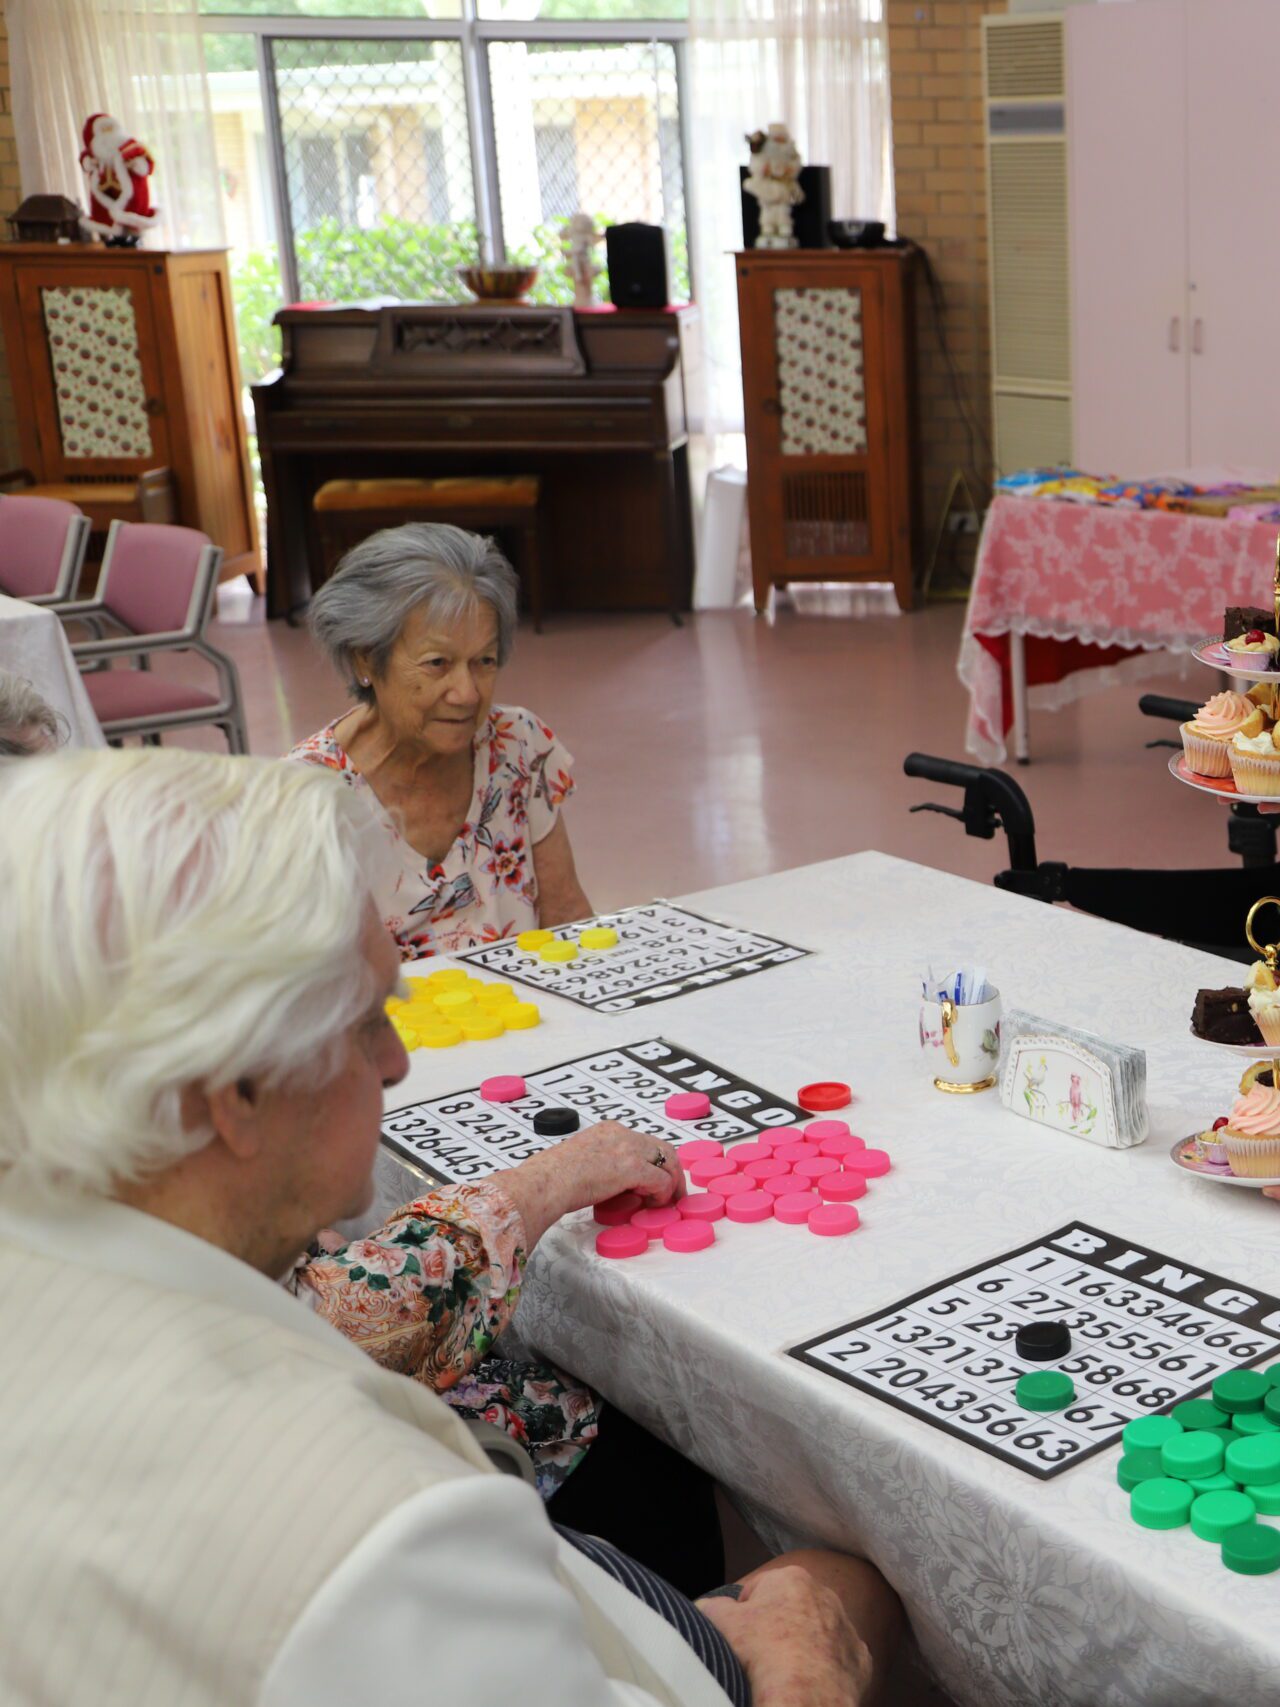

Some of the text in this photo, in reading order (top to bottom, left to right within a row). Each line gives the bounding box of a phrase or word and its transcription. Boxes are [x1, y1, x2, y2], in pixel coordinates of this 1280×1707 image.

[571, 986, 619, 1000] 72
[543, 1074, 574, 1086] 1
[559, 1086, 609, 1105] 25
[627, 1041, 796, 1126] BINGO
[439, 1102, 474, 1114] 8
[590, 1060, 624, 1072] 3
[608, 1072, 656, 1089] 29
[694, 1120, 744, 1139] 63
[383, 1111, 426, 1132] 13
[456, 1114, 508, 1134] 24
[402, 1128, 452, 1150] 26
[484, 1131, 532, 1150] 31
[432, 1147, 480, 1167] 44
[1026, 1257, 1266, 1358] 1 16 33 46 66
[976, 1278, 1219, 1381] 6 27 35 55 61
[928, 1298, 1176, 1407] 5 23 58 68
[875, 1316, 1132, 1432] 13 21 37 67
[827, 1341, 1080, 1462] 2 20 43 56 63
